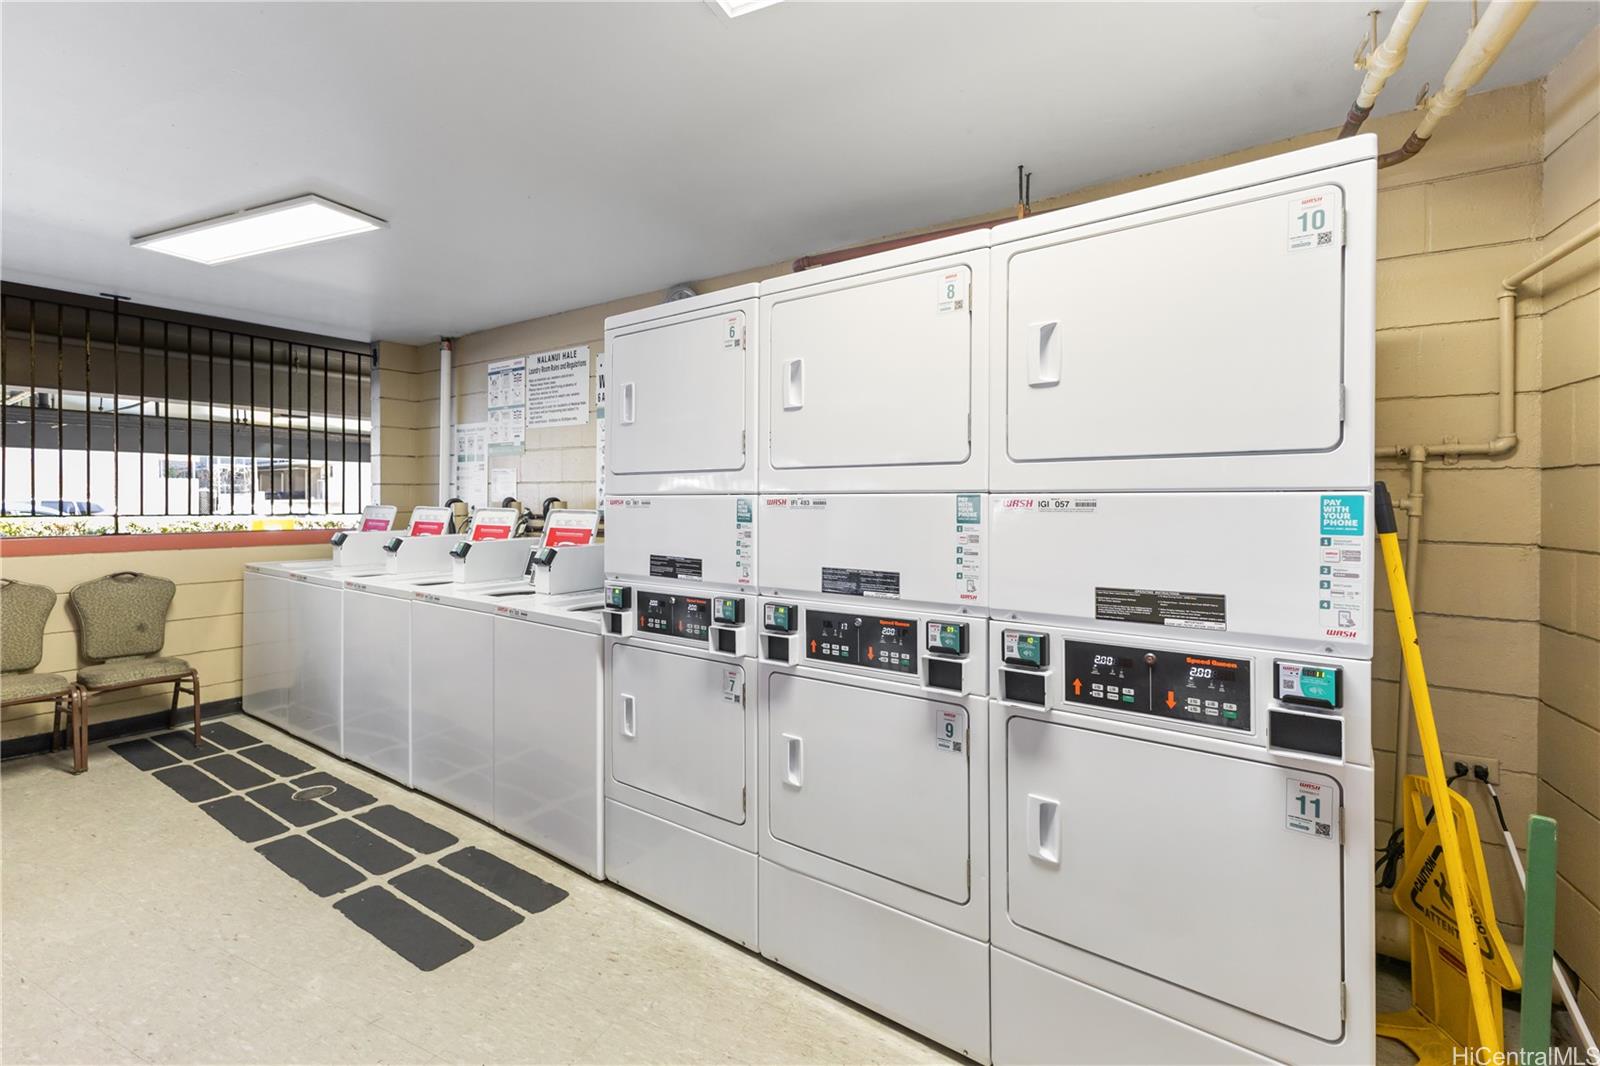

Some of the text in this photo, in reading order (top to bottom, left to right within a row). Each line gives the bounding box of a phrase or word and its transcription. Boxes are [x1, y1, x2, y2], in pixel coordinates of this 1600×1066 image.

[1297, 209, 1325, 232] 10
[947, 284, 955, 299] 8
[729, 325, 736, 338] 6
[562, 350, 577, 360] HALE
[767, 498, 788, 506] WASH
[1003, 498, 1034, 509] WASH
[1054, 500, 1070, 508] 057
[1323, 512, 1351, 520] YOUR
[1323, 519, 1359, 527] PHONE
[1326, 628, 1358, 639] WASH
[1186, 656, 1239, 669] Speed Queen
[729, 679, 736, 692] 7
[945, 722, 954, 739] 9
[1299, 782, 1321, 791] WASH
[1295, 795, 1321, 819] 11
[1413, 855, 1438, 893] CAUTION
